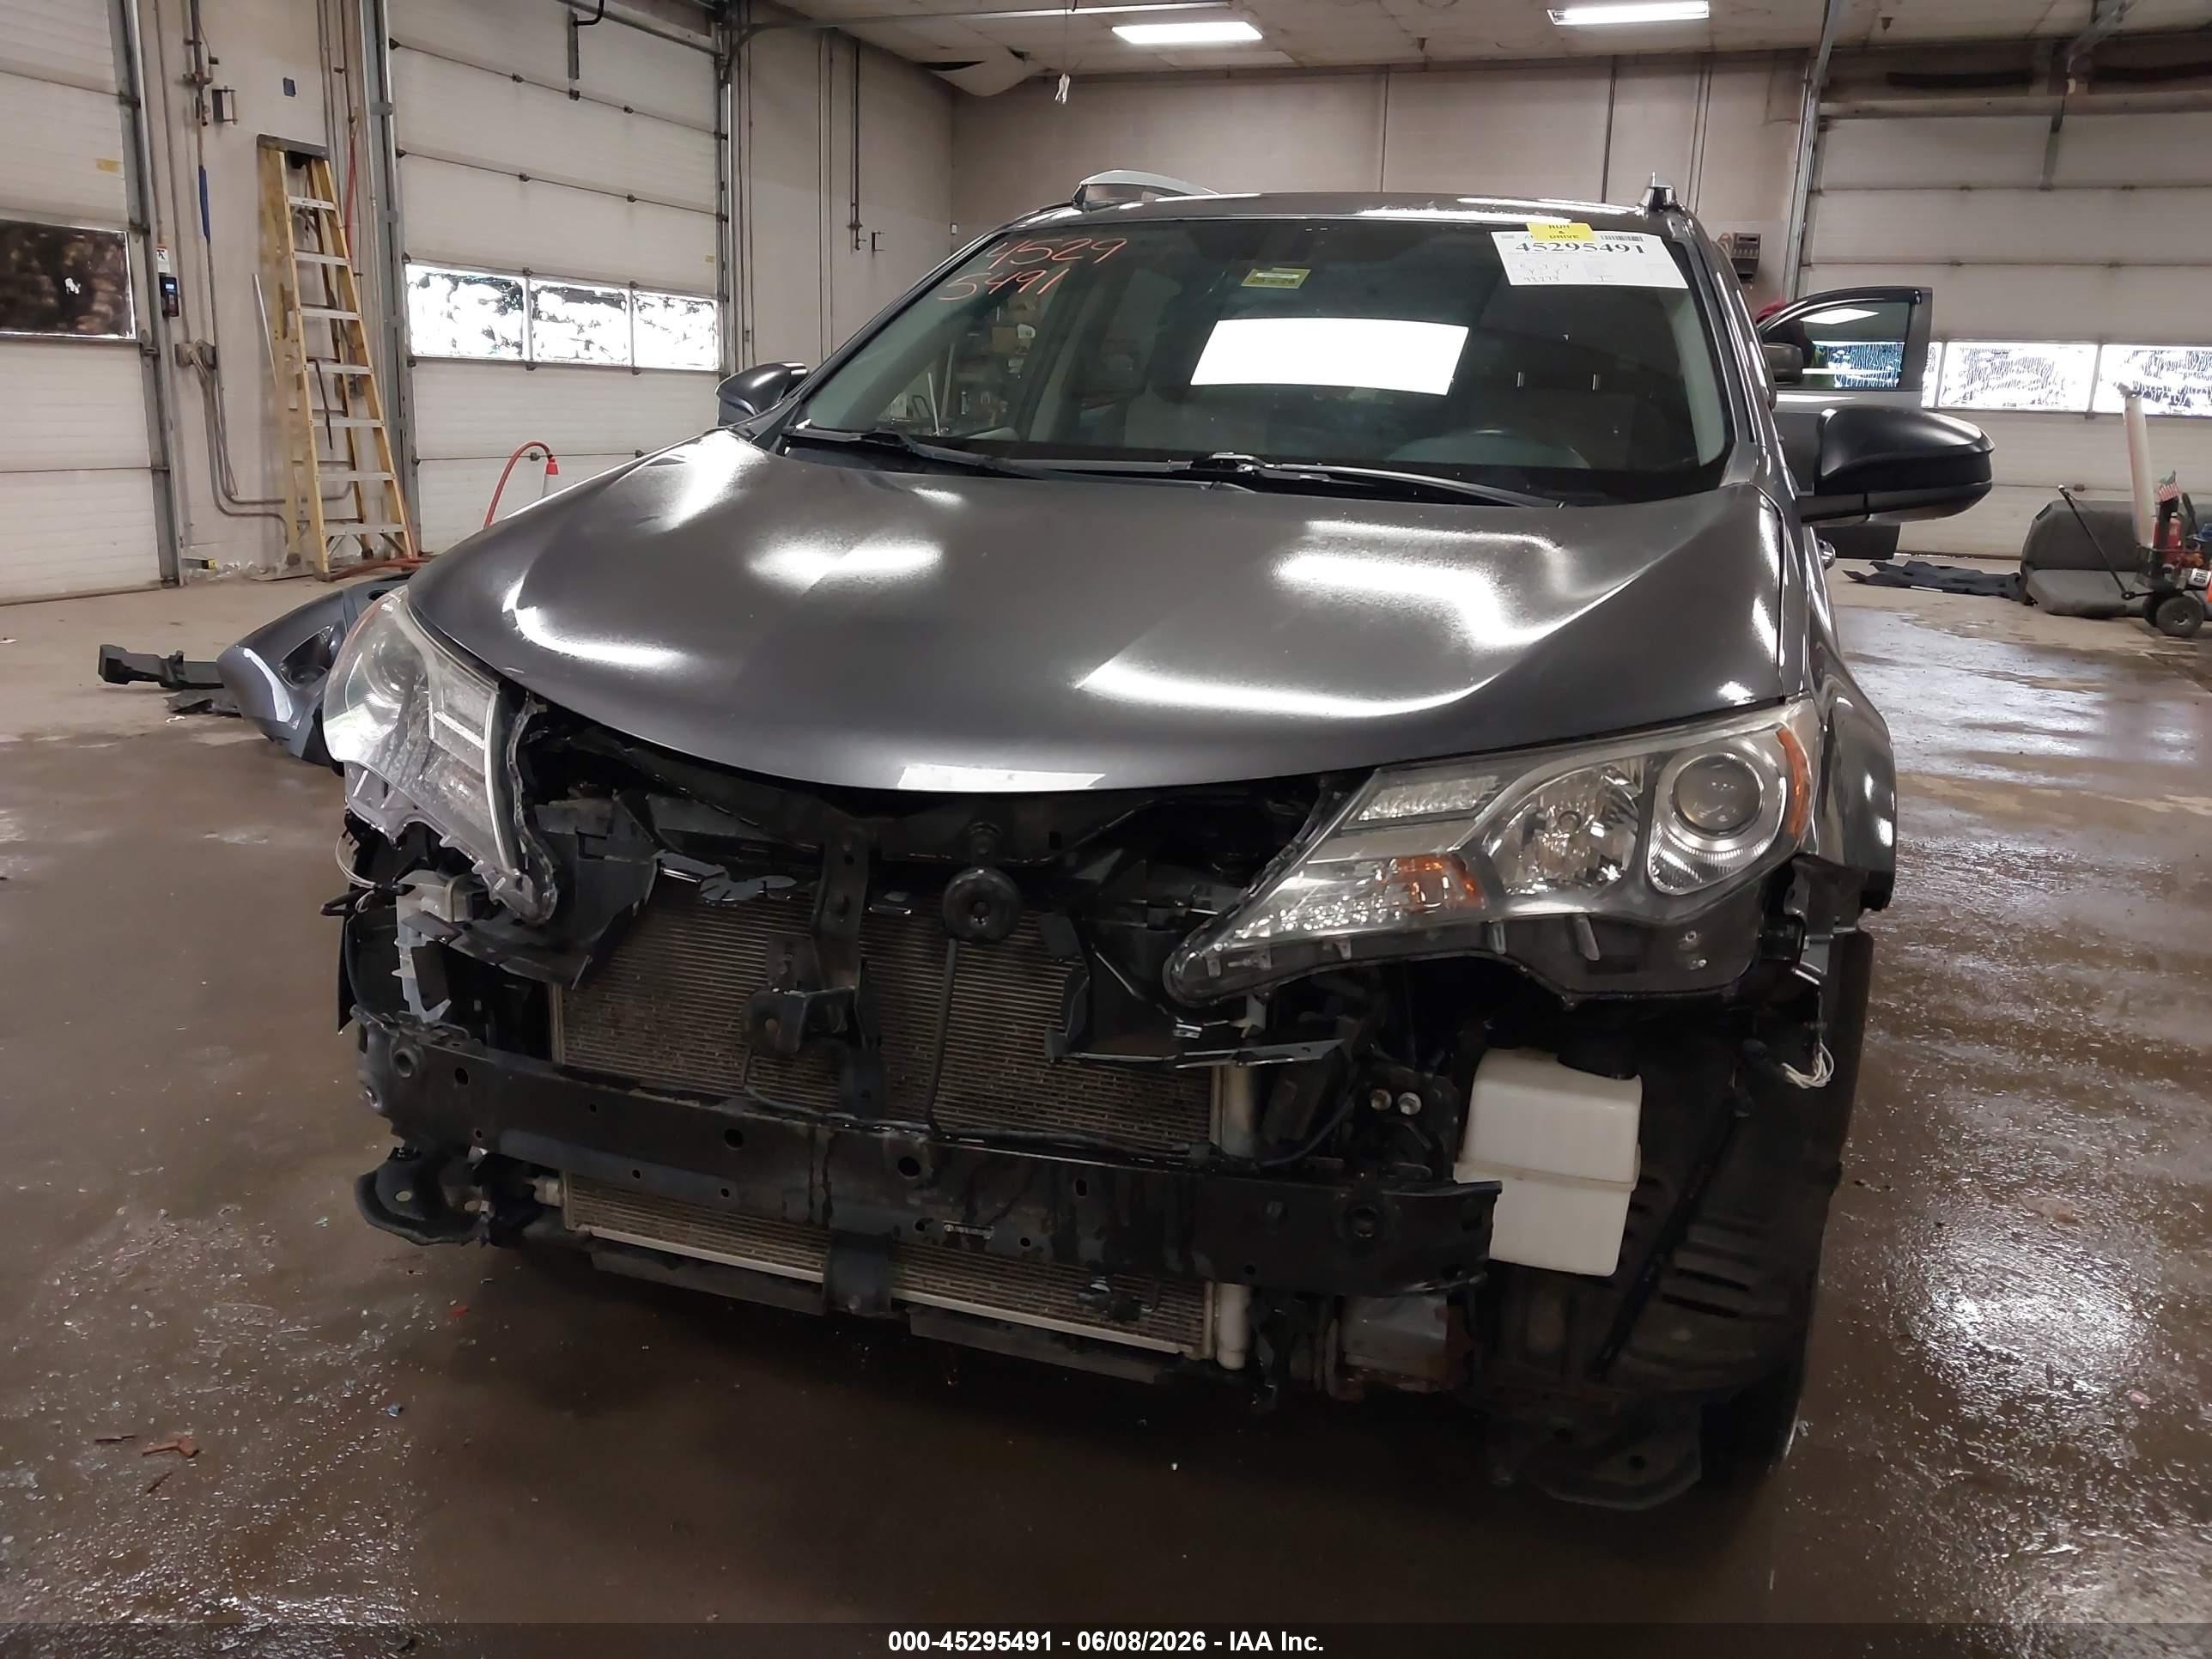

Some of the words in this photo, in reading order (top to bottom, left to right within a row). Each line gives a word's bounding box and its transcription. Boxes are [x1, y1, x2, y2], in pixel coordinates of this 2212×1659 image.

[987, 238, 1127, 270] 4529
[1516, 242, 1646, 254] 45295491
[939, 268, 1070, 301] 5491
